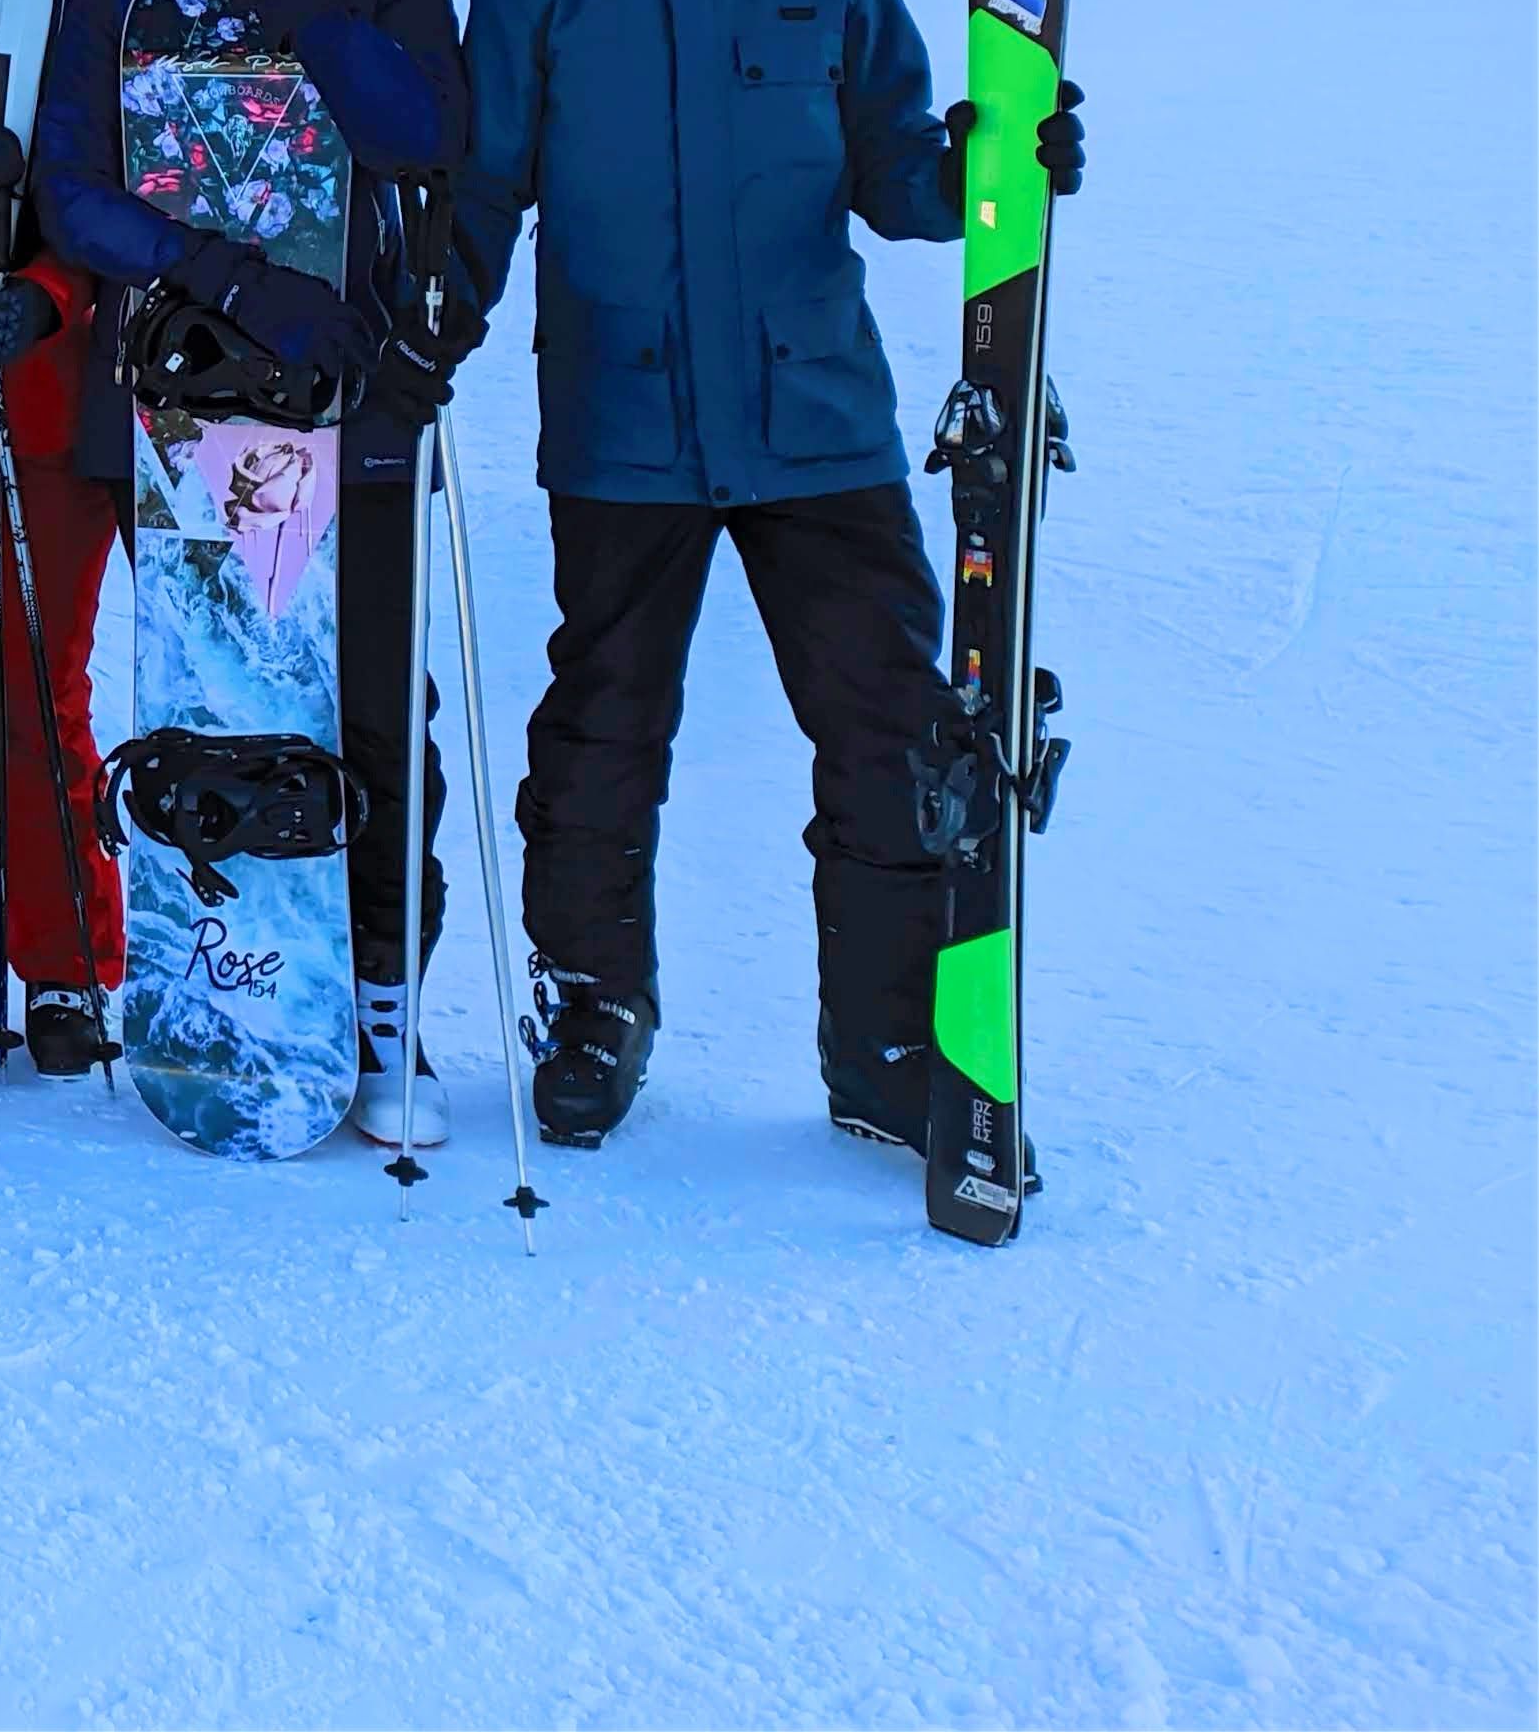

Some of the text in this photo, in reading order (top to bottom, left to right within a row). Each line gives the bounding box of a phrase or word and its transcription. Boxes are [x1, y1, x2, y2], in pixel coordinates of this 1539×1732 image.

[197, 82, 283, 107] NOWBOARDS
[974, 302, 993, 355] 159
[185, 917, 285, 993] Rose
[247, 978, 277, 1001] 154
[973, 1099, 984, 1143] PRO
[982, 1101, 994, 1144] MTN
